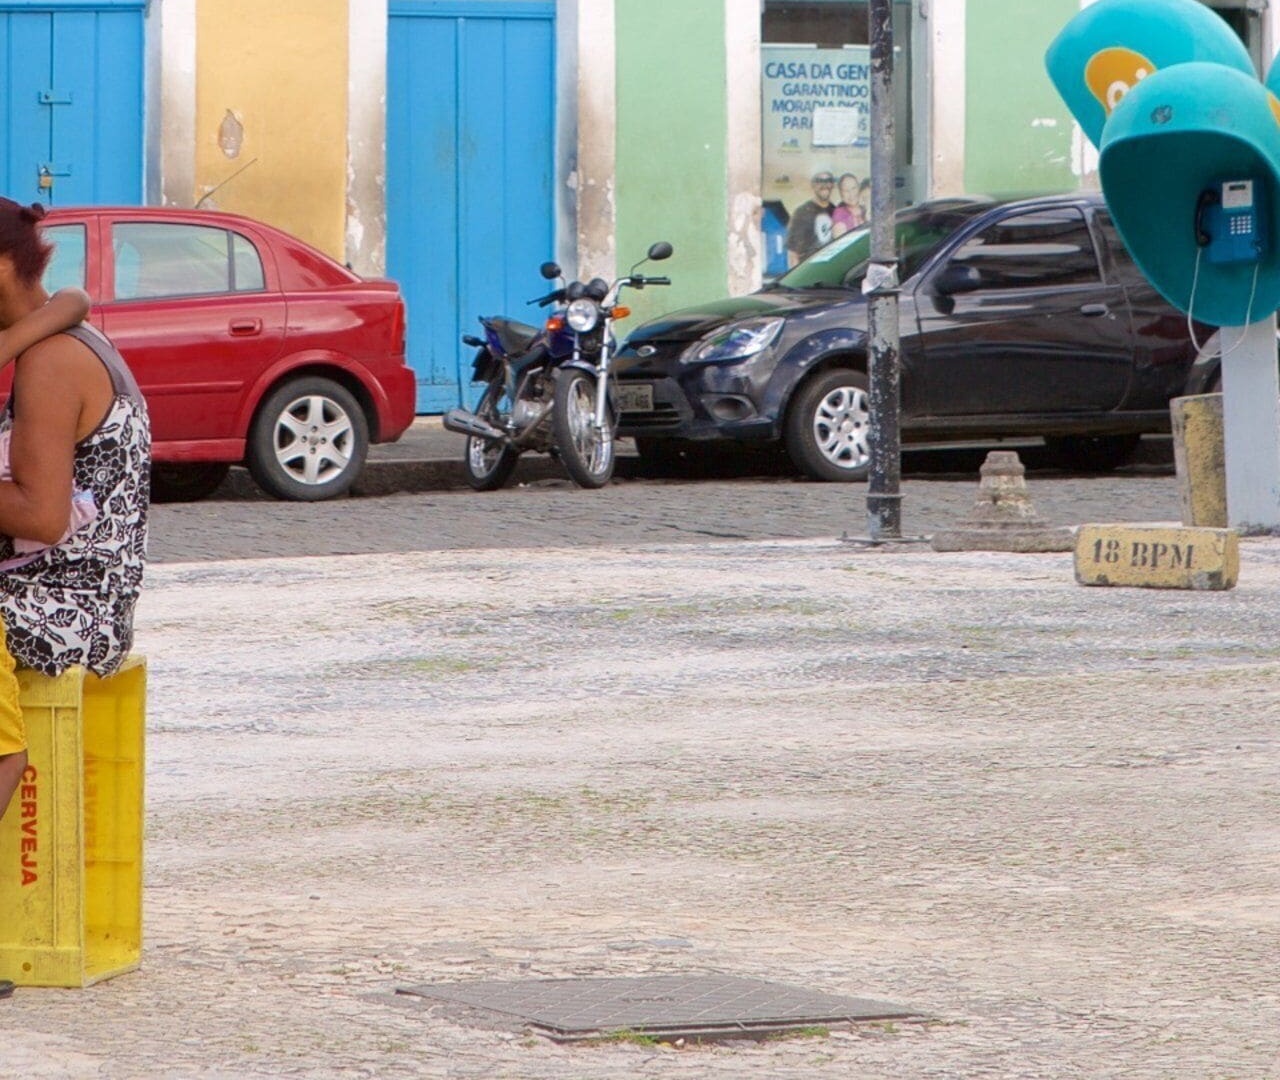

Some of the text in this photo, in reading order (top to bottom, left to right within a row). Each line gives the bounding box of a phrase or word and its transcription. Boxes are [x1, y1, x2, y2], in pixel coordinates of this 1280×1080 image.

[765, 62, 869, 80] CASA DA GEN
[783, 83, 868, 97] GARANTINDO
[1093, 539, 1194, 569] 18 BPM
[21, 765, 37, 886] CERVEJA
